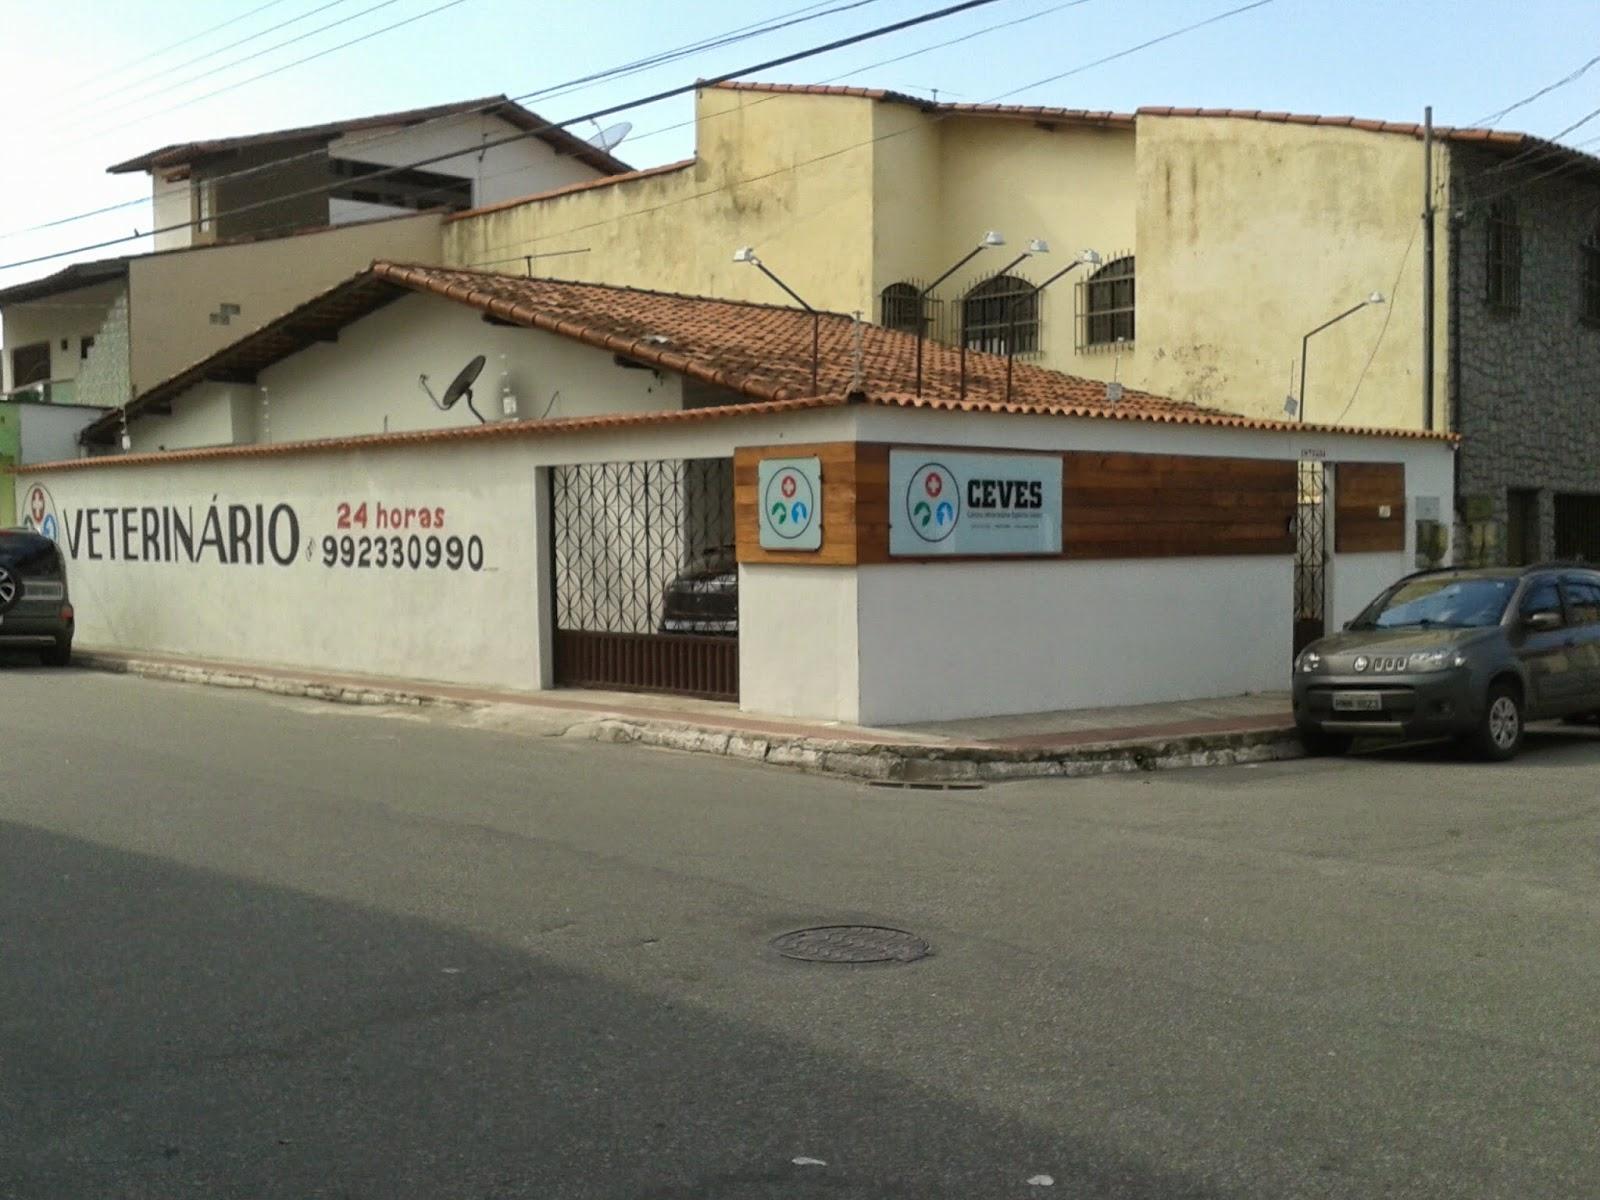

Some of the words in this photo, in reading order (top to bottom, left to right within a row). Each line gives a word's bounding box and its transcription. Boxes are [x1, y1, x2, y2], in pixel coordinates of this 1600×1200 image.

[968, 479, 1043, 508] CEVES
[63, 494, 300, 566] VETERINÁRIO
[337, 502, 368, 529] 24
[376, 502, 445, 529] horas
[322, 534, 484, 571] 992330990
